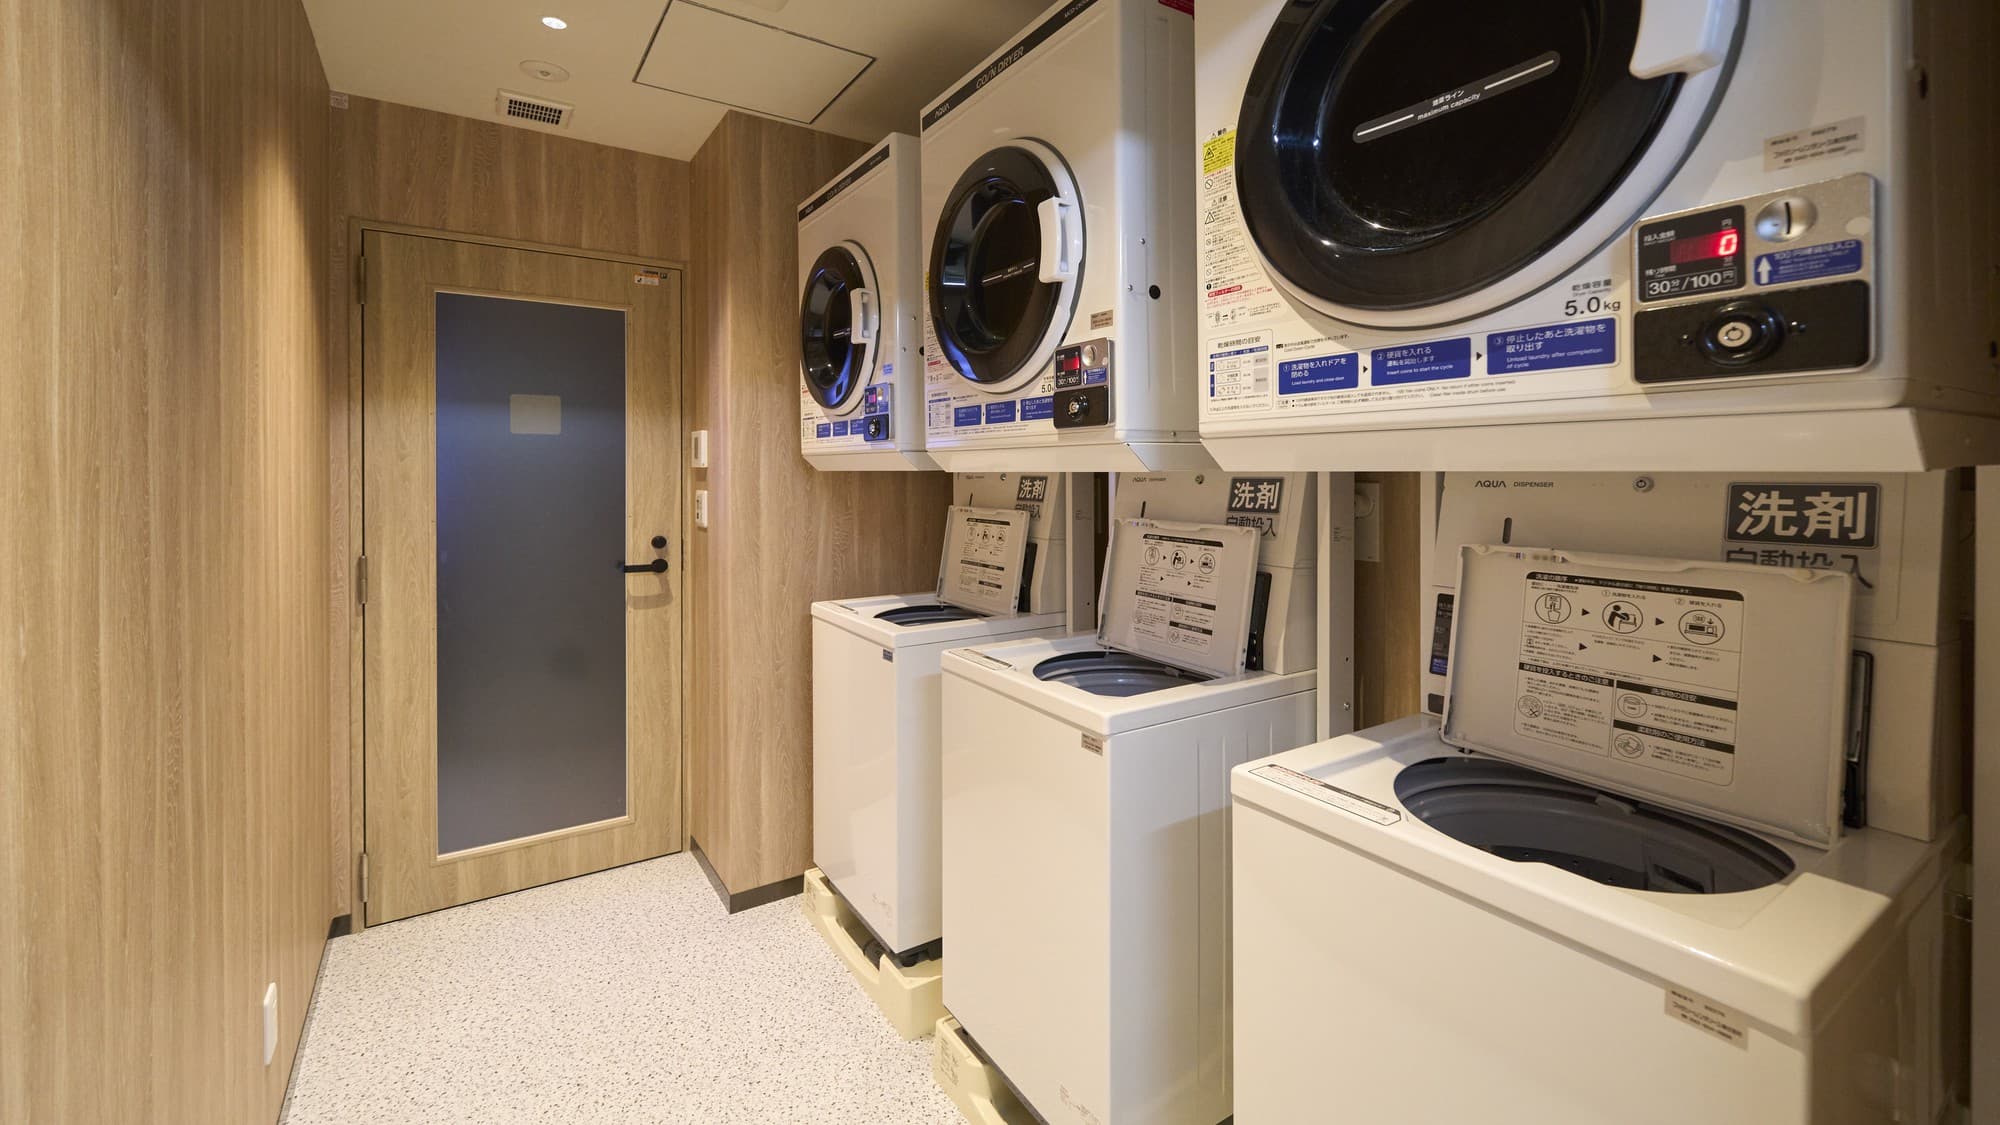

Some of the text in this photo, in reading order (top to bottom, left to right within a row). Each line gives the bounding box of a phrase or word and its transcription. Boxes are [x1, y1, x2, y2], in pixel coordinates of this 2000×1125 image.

[997, 46, 1025, 73] DRYER
[1417, 93, 1481, 121] maximum capacity
[1718, 233, 1738, 256] 0
[1564, 296, 1621, 317] 5.0 kg
[1386, 347, 1432, 360] 硬貨を入れる
[1506, 341, 1544, 353] 取り出す
[1019, 480, 1046, 499] 洗剤
[1474, 480, 1507, 489] AQUA
[1231, 482, 1280, 510] 洗剤
[1736, 491, 1869, 541] 洗剤
